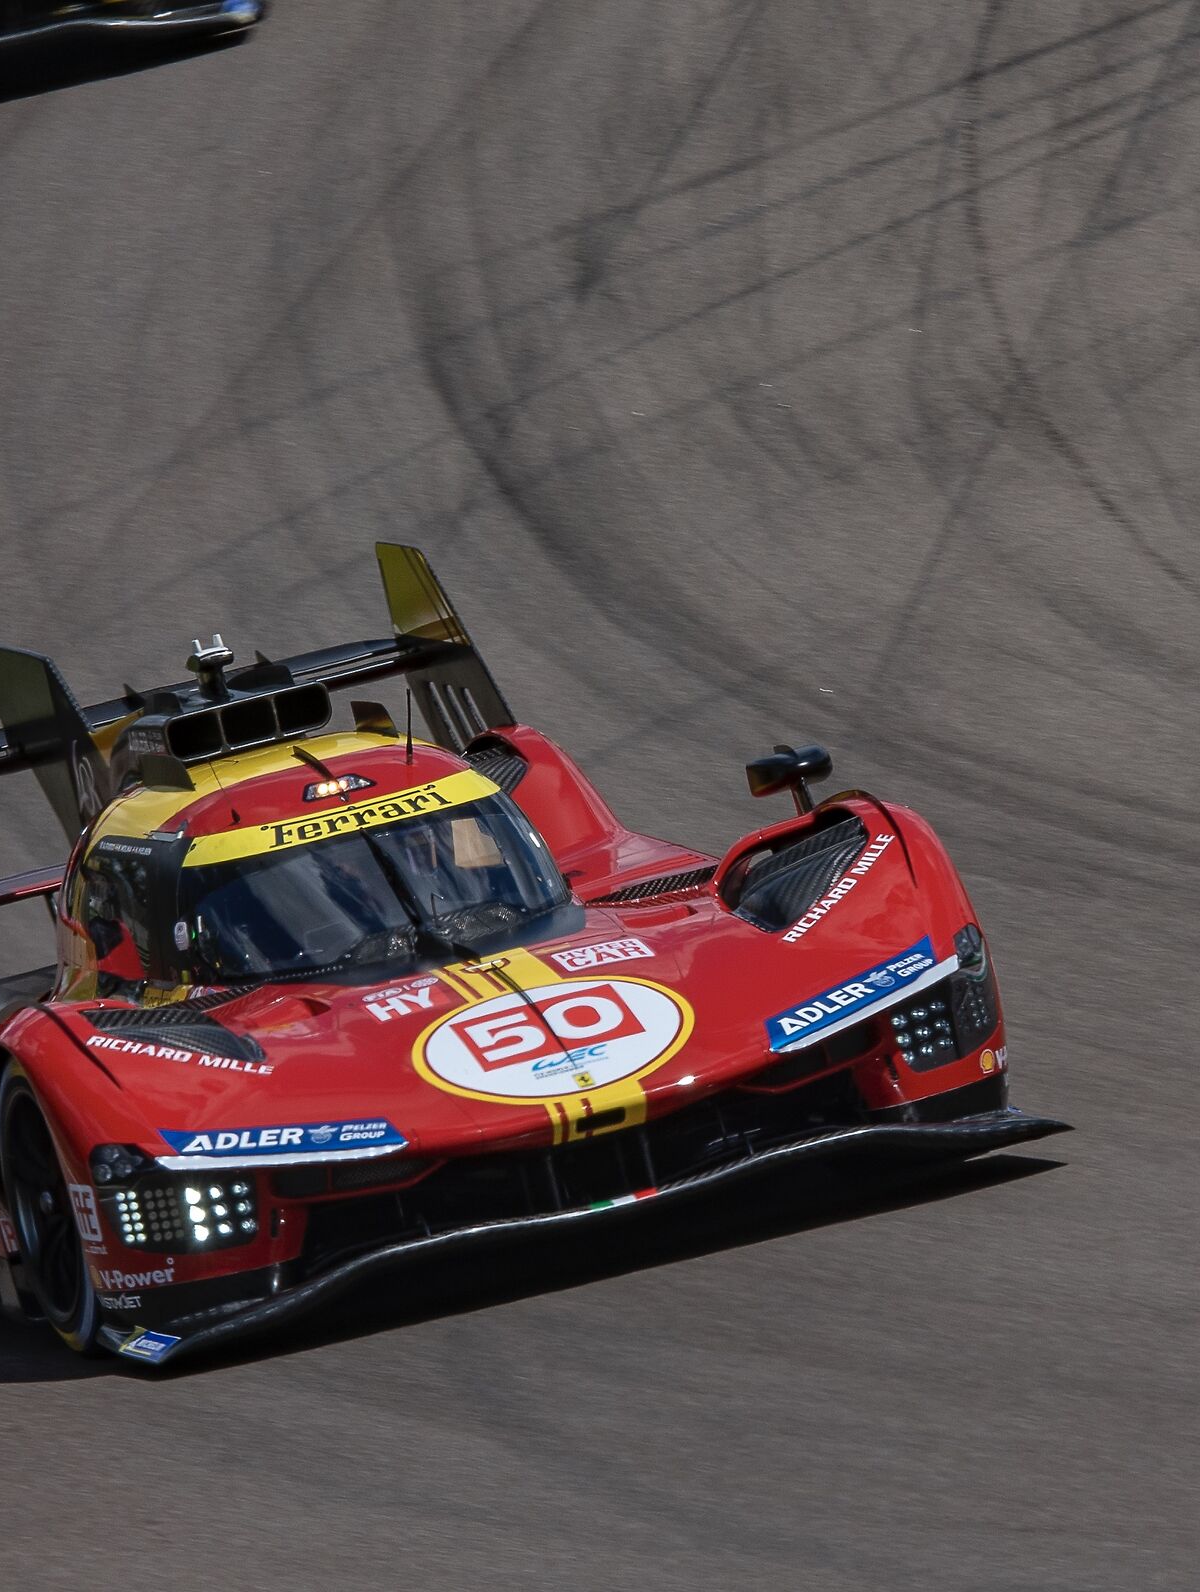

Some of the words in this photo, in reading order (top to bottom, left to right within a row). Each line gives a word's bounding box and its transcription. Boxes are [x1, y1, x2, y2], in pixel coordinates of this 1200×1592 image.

[261, 784, 452, 850] Ferrari
[781, 877, 858, 944] RICHARD
[850, 833, 896, 876] MILLE
[553, 939, 640, 961] HYPER
[565, 947, 645, 969] CAR
[886, 953, 925, 973] PELZER
[898, 958, 934, 978] GROUP
[365, 987, 434, 1022] HY
[777, 981, 875, 1036] ADLER
[464, 996, 624, 1063] 50
[86, 1035, 193, 1064] RICHARD
[197, 1055, 275, 1075] MILLE
[339, 1130, 387, 1141] GROUP
[340, 1121, 388, 1132] PELZER
[181, 1127, 305, 1152] ADLER
[99, 1266, 176, 1289] V-Power
